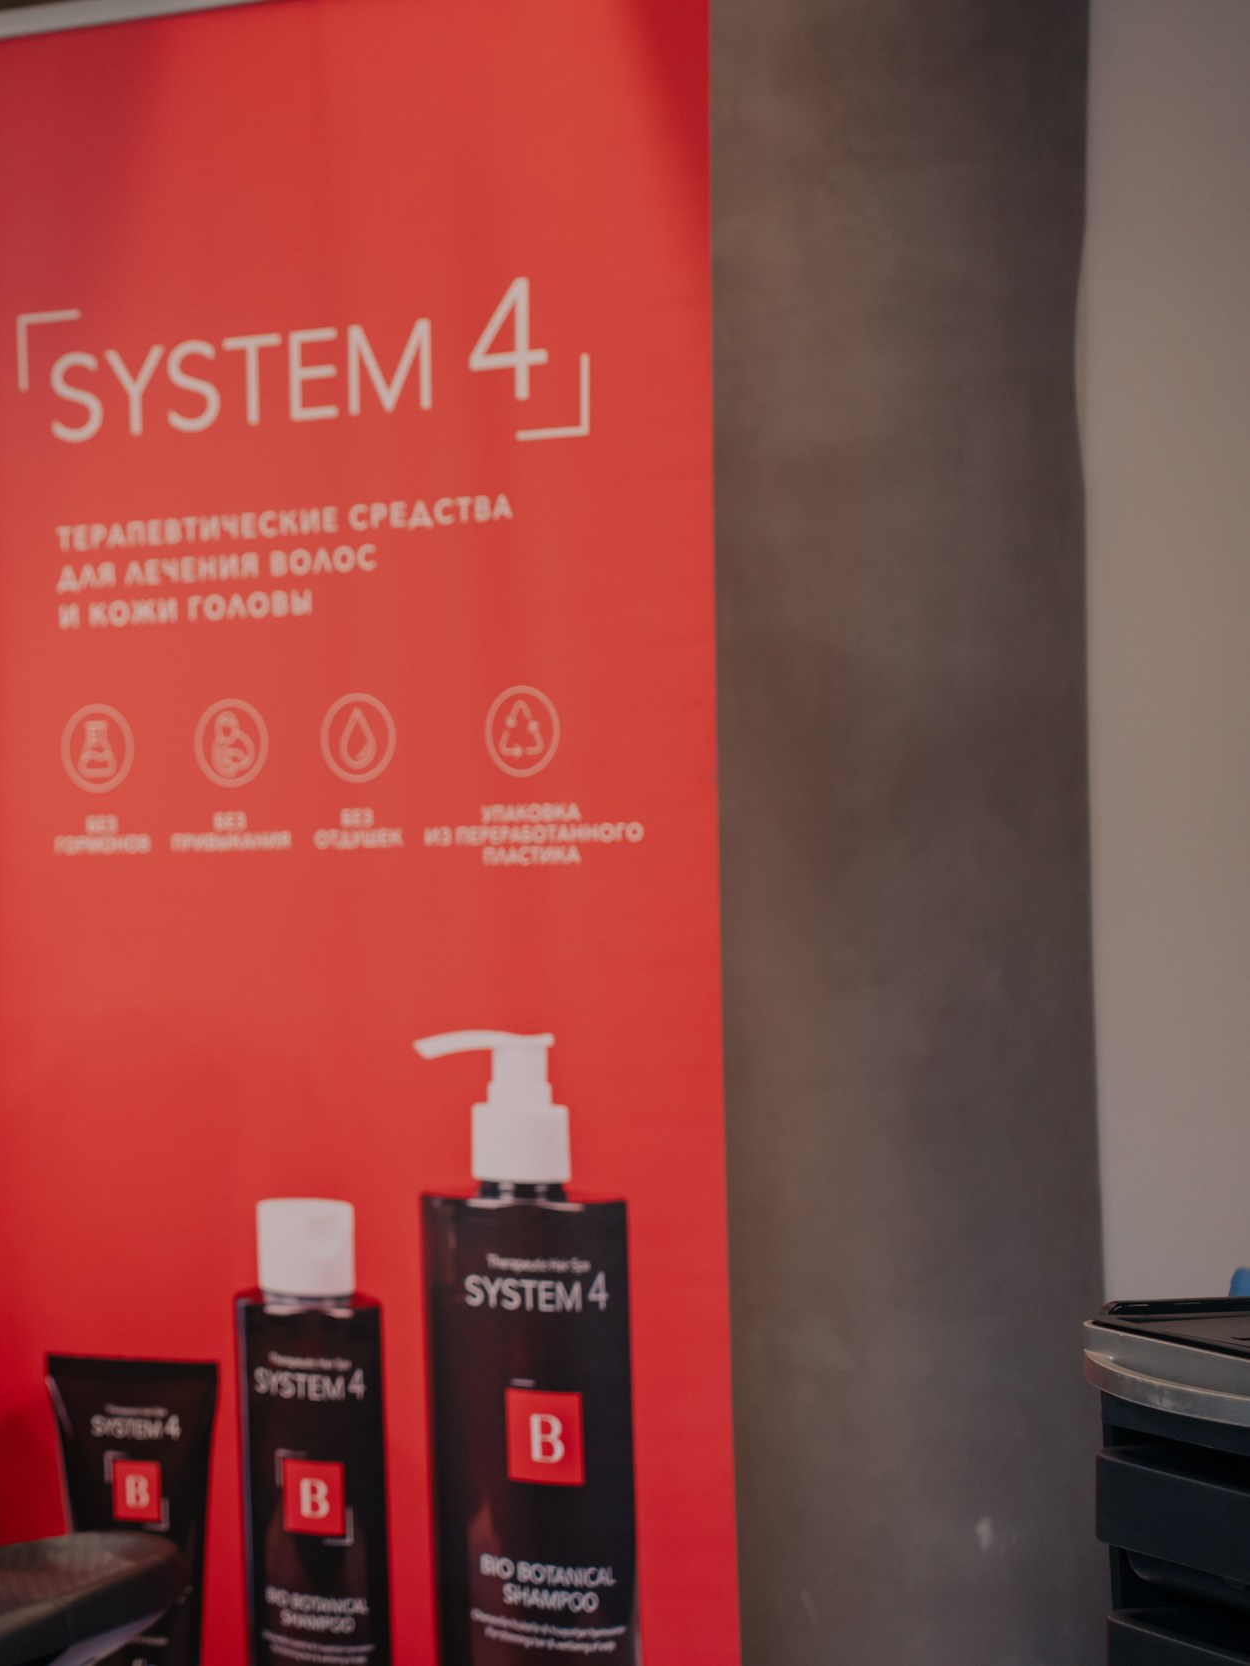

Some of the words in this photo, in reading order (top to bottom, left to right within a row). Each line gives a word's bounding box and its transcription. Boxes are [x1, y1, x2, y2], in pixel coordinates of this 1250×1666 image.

[49, 317, 433, 443] SYSTEM
[468, 275, 549, 400] 4
[55, 506, 339, 552] ТЕРАПЕВТИЧЕСКИЕ
[348, 493, 514, 531] СРЕДСТВА
[55, 562, 116, 594] ДЛЯ
[124, 552, 260, 587] ЛЕЧЕНИЯ
[269, 543, 378, 578] ВОЛОС
[58, 603, 81, 630] И
[88, 597, 178, 628] КОЖИ
[187, 589, 313, 622] ГОЛОВЫ
[481, 802, 582, 824] УПАКОВКА
[454, 821, 645, 846] ПЕРЕРАБОТАННОГО
[482, 845, 582, 866] ПЛАСТИКА
[464, 1274, 583, 1313] SYSTEM
[587, 1270, 610, 1311] 4
[253, 1366, 346, 1401] SYSTEM
[347, 1367, 367, 1401] 4
[90, 1414, 164, 1440] SYSTEM
[163, 1413, 182, 1440] 4
[530, 1413, 565, 1464] B
[125, 1473, 150, 1509] B
[299, 1477, 330, 1519] B
[480, 1553, 515, 1580] BIO
[516, 1560, 617, 1588] BOTANICAL
[502, 1582, 599, 1613] SHAMPOO
